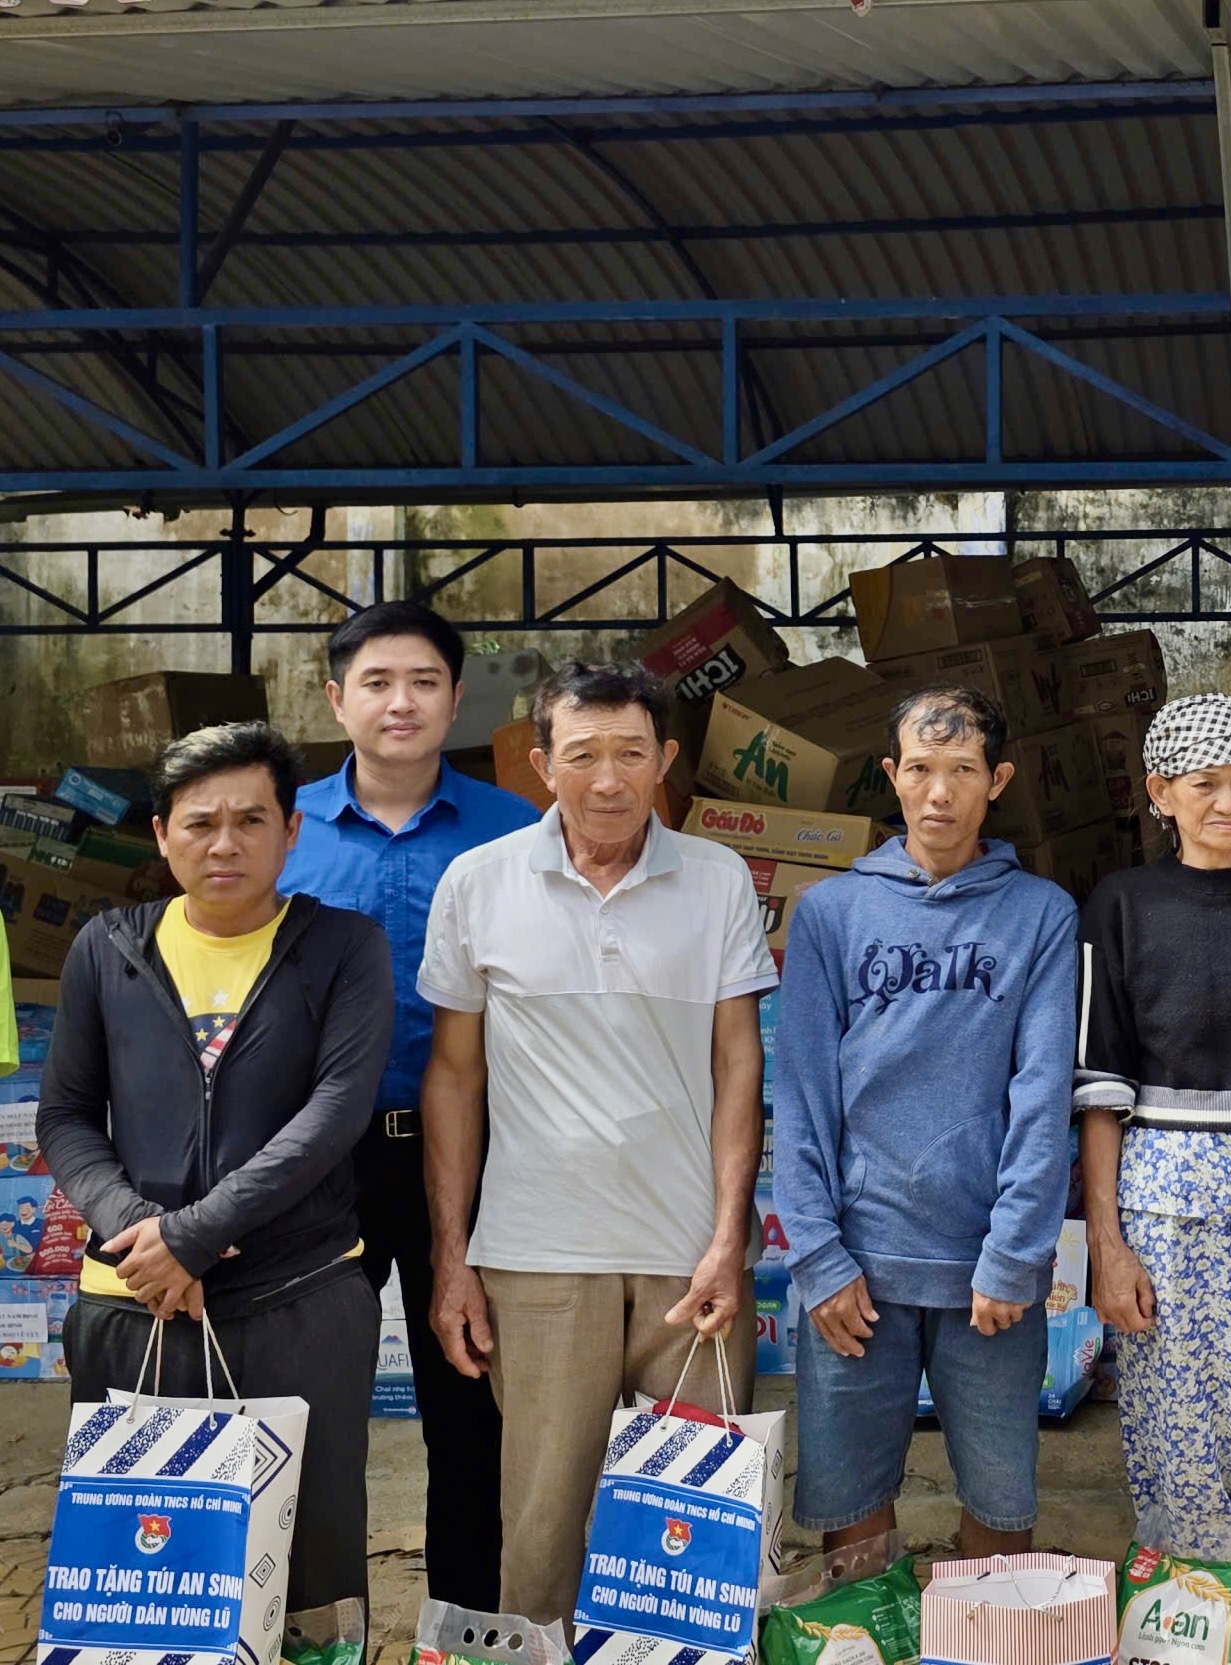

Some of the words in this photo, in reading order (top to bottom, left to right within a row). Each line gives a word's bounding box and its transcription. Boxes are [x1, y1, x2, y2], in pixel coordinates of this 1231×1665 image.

[679, 650, 739, 699] ICHI
[733, 729, 789, 803] An
[701, 807, 739, 832] Gấu
[739, 812, 766, 835] Đỏ
[71, 1492, 103, 1506] TRUNG
[105, 1492, 133, 1506] ƯƠNG
[135, 1492, 162, 1508] ĐOÀN
[164, 1495, 188, 1509] TNCS
[205, 1496, 221, 1512] CHÍ
[222, 1500, 242, 1515] MINH
[612, 1488, 641, 1503] TRUNG
[664, 1497, 686, 1514] ĐOÀN
[686, 1504, 707, 1519] TNCS
[720, 1511, 736, 1526] CHÍ
[48, 1566, 92, 1592] TRAO
[96, 1564, 142, 1597] TẶNG
[147, 1567, 175, 1594] TÚI
[177, 1572, 203, 1596] AN
[208, 1574, 243, 1600] SINH
[588, 1554, 627, 1579] TRAO
[629, 1558, 667, 1589] TẶNG
[670, 1568, 693, 1596] TÚI
[694, 1578, 717, 1602] AN
[718, 1582, 757, 1609] SINH
[53, 1602, 82, 1622] CHO
[85, 1600, 133, 1624] NGƯỜI
[135, 1604, 167, 1626] DÂN
[170, 1604, 210, 1628] VÙNG
[213, 1608, 231, 1629] LŨ
[592, 1584, 617, 1606] CHO
[618, 1592, 659, 1616] NGƯỜI
[660, 1598, 686, 1622] DÂN
[688, 1604, 722, 1628] VÙNG
[724, 1612, 741, 1633] LŨ
